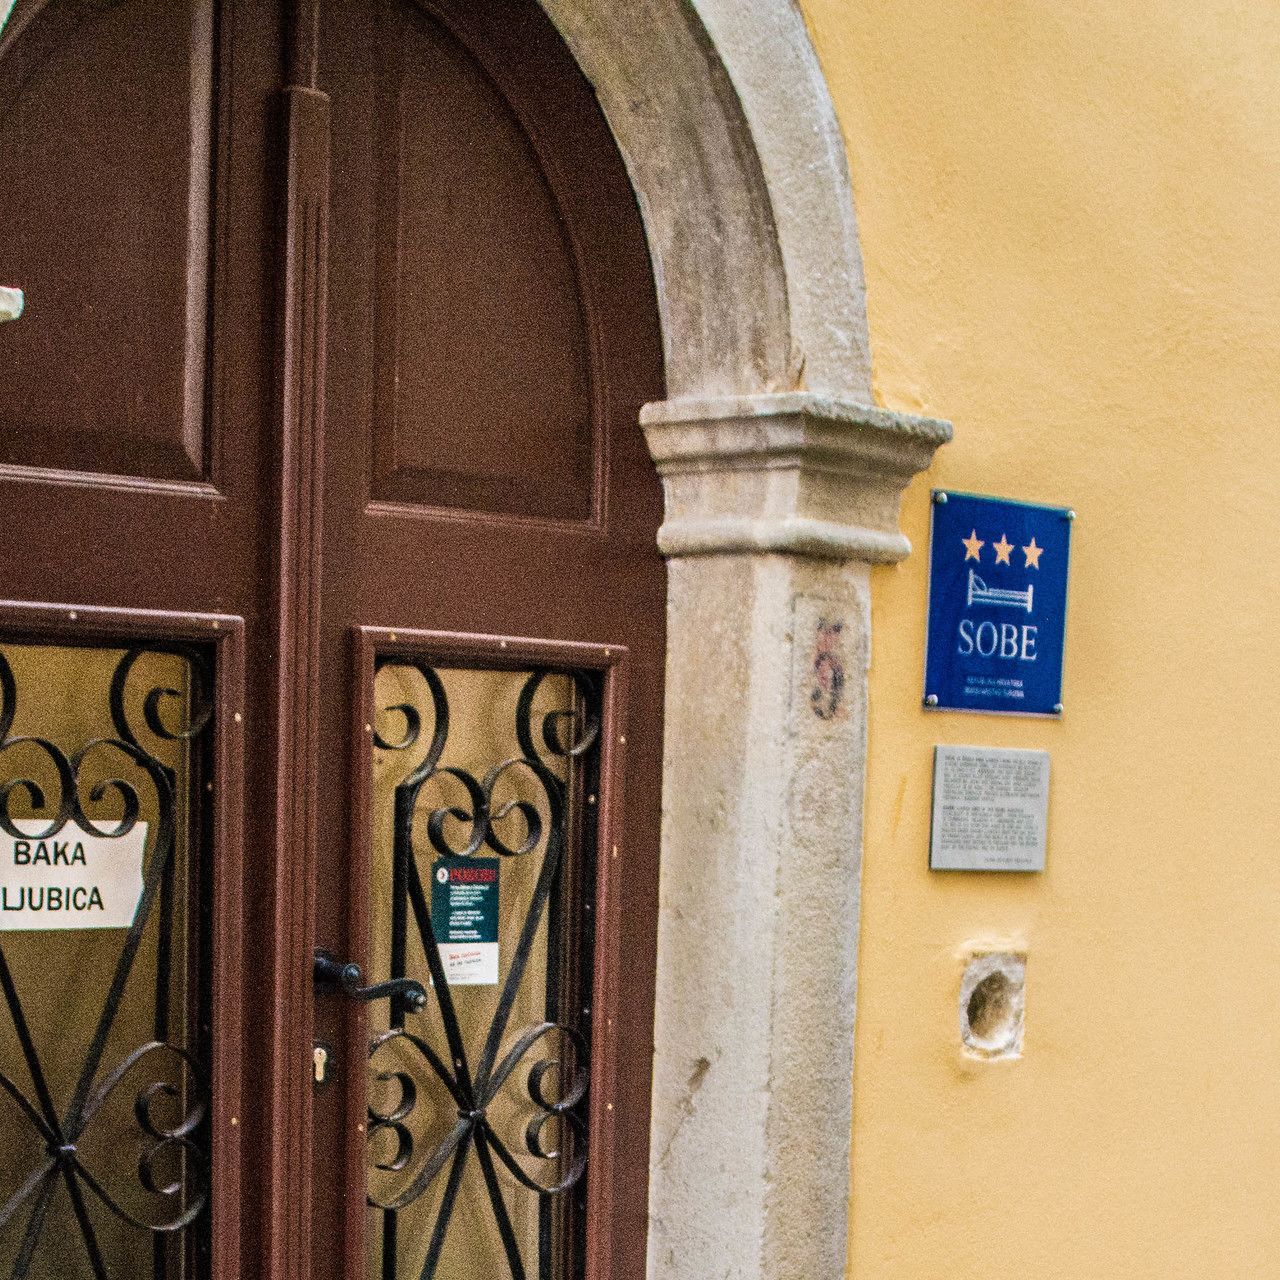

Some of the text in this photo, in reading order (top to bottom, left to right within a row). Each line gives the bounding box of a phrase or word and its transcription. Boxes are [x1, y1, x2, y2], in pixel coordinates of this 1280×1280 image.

[958, 619, 1038, 661] SOBE
[14, 840, 87, 865] BAKA
[2, 886, 105, 911] LJUBICA
